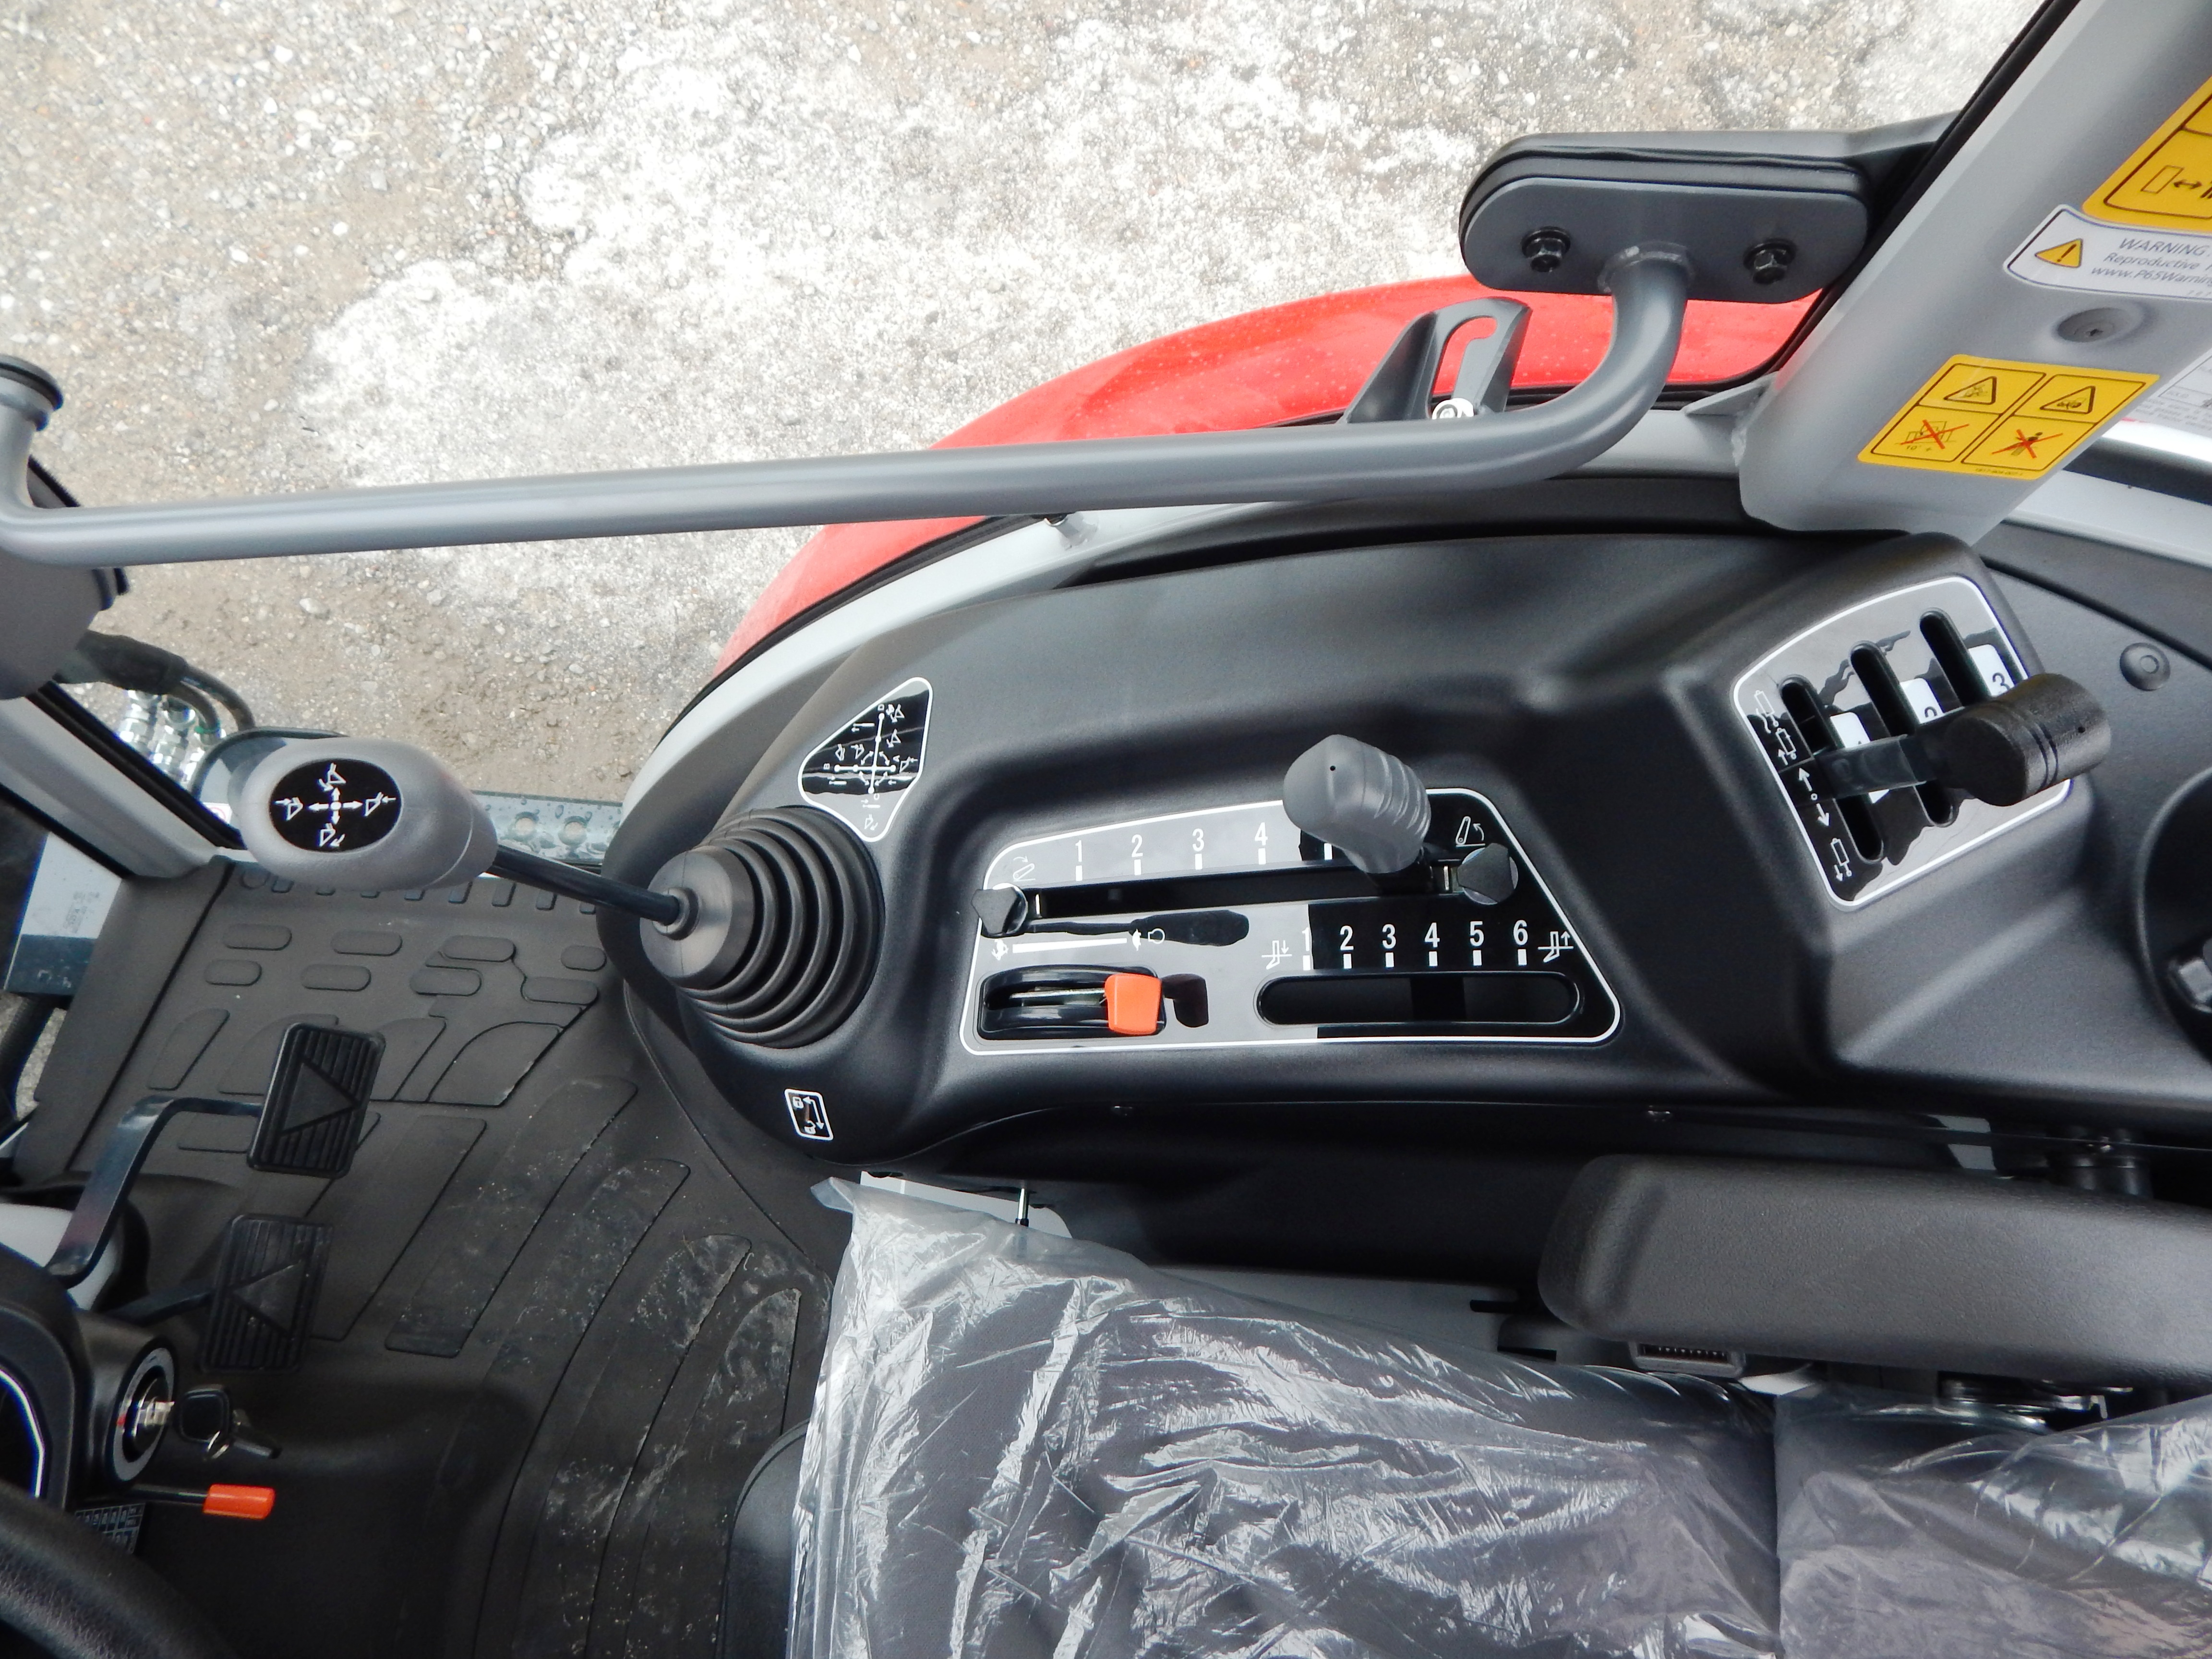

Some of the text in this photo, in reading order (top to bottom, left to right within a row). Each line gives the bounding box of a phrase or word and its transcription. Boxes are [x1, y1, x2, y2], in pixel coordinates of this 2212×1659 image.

[2103, 252, 2201, 270] Reproductive
[1075, 822, 1268, 862] 1 2 3 4
[1301, 920, 1528, 951] 1 2 3 4 5 6
